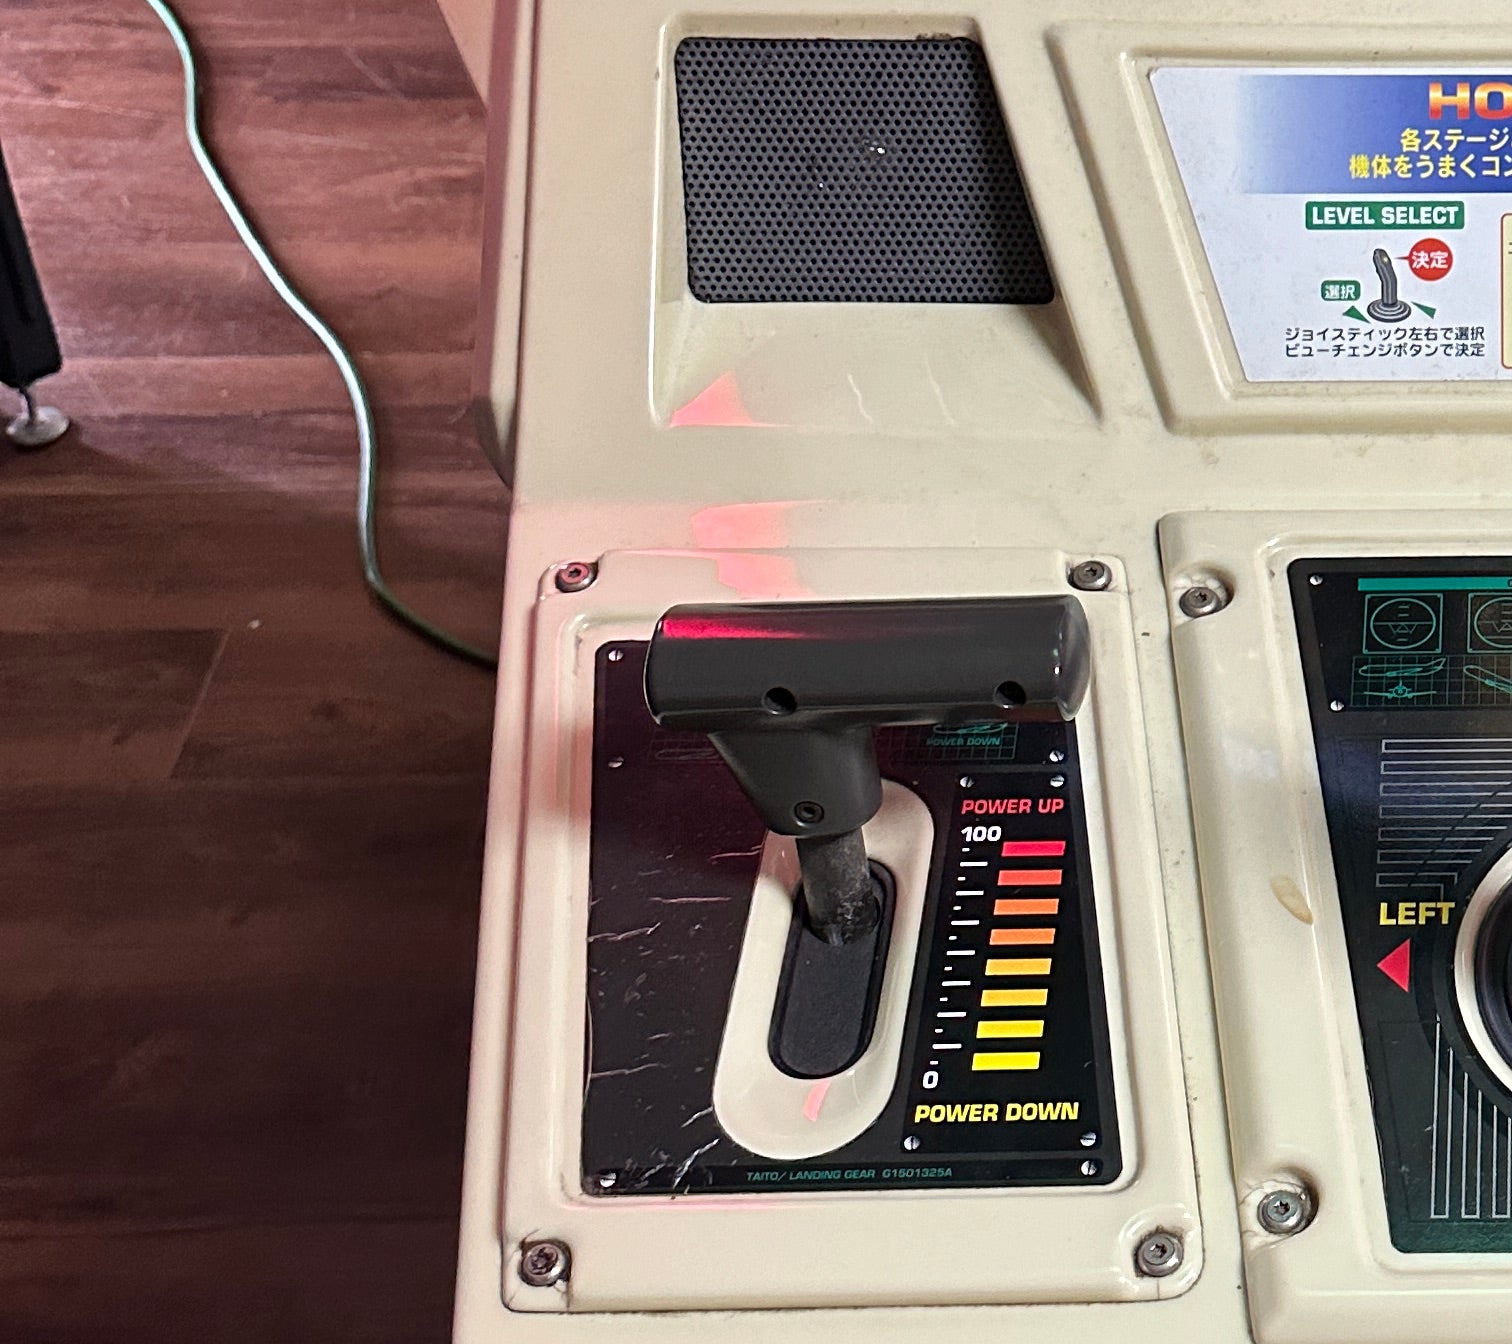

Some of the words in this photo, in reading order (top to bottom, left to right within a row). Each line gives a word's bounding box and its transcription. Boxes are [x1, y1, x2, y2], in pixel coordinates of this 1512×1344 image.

[1312, 206, 1376, 225] LEVEL
[1381, 206, 1460, 225] SELECT
[1410, 250, 1449, 270] 決定
[1324, 284, 1356, 299] 選択
[1285, 326, 1485, 341] ジョイスティック左右で選択
[1285, 341, 1485, 357] ビューチェンジボタンで決定
[966, 736, 1001, 746] DOWN
[961, 798, 1032, 815] POWER
[1037, 798, 1065, 814] UP
[961, 825, 1002, 842] 100
[1379, 901, 1456, 927] LEFT
[921, 1070, 939, 1090] 0
[914, 1102, 999, 1123] POWER
[1004, 1101, 1079, 1122] DOWN
[788, 1169, 843, 1181] LANDING
[843, 1168, 876, 1180] GEAR
